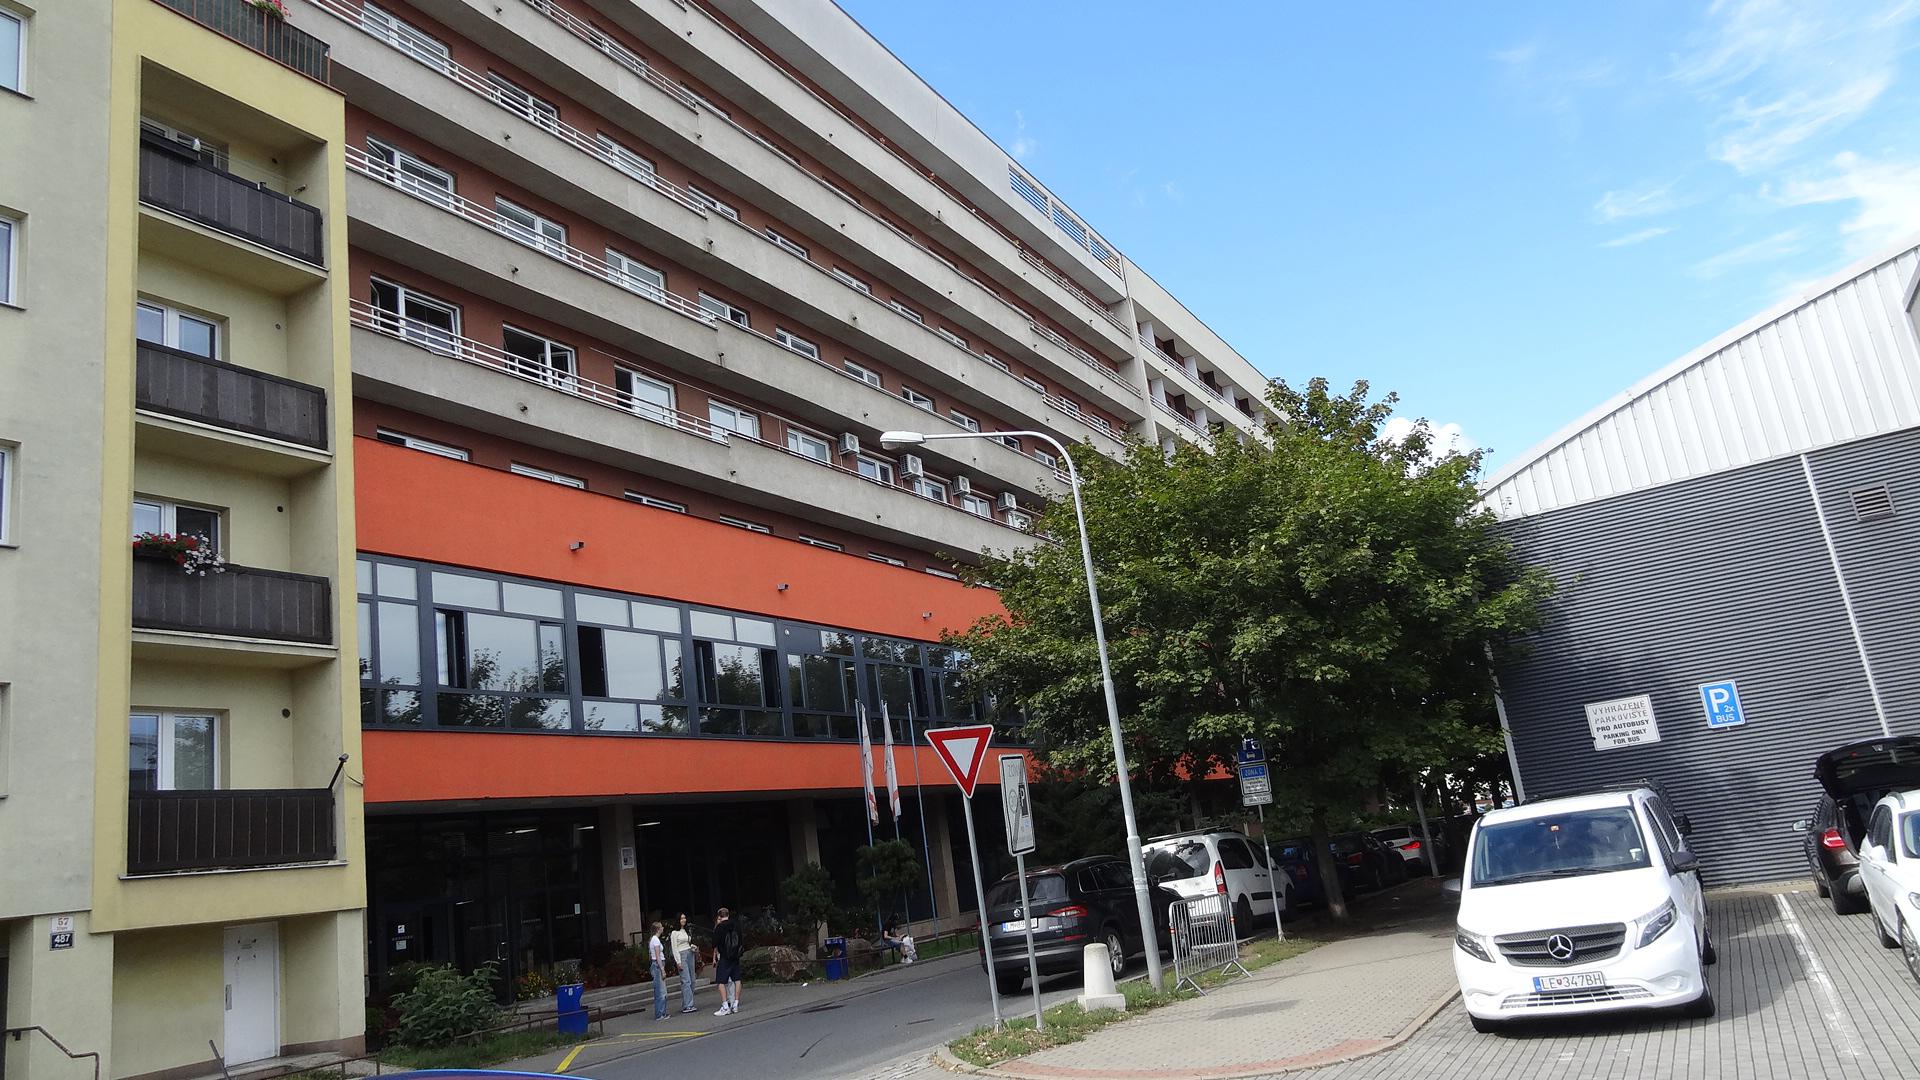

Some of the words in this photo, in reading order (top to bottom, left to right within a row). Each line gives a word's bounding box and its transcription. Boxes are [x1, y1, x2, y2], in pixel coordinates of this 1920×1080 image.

[1709, 688, 1729, 713] P
[1715, 713, 1735, 723] BUS
[1596, 725, 1611, 733] PRO
[1613, 719, 1650, 730] AUTOBUSY
[1602, 731, 1630, 740] PARKING
[1631, 728, 1647, 736] ONLY
[1627, 735, 1641, 743] BUS
[54, 934, 70, 943] 487
[1541, 977, 1557, 989] LE
[1563, 974, 1602, 987] 347BH
